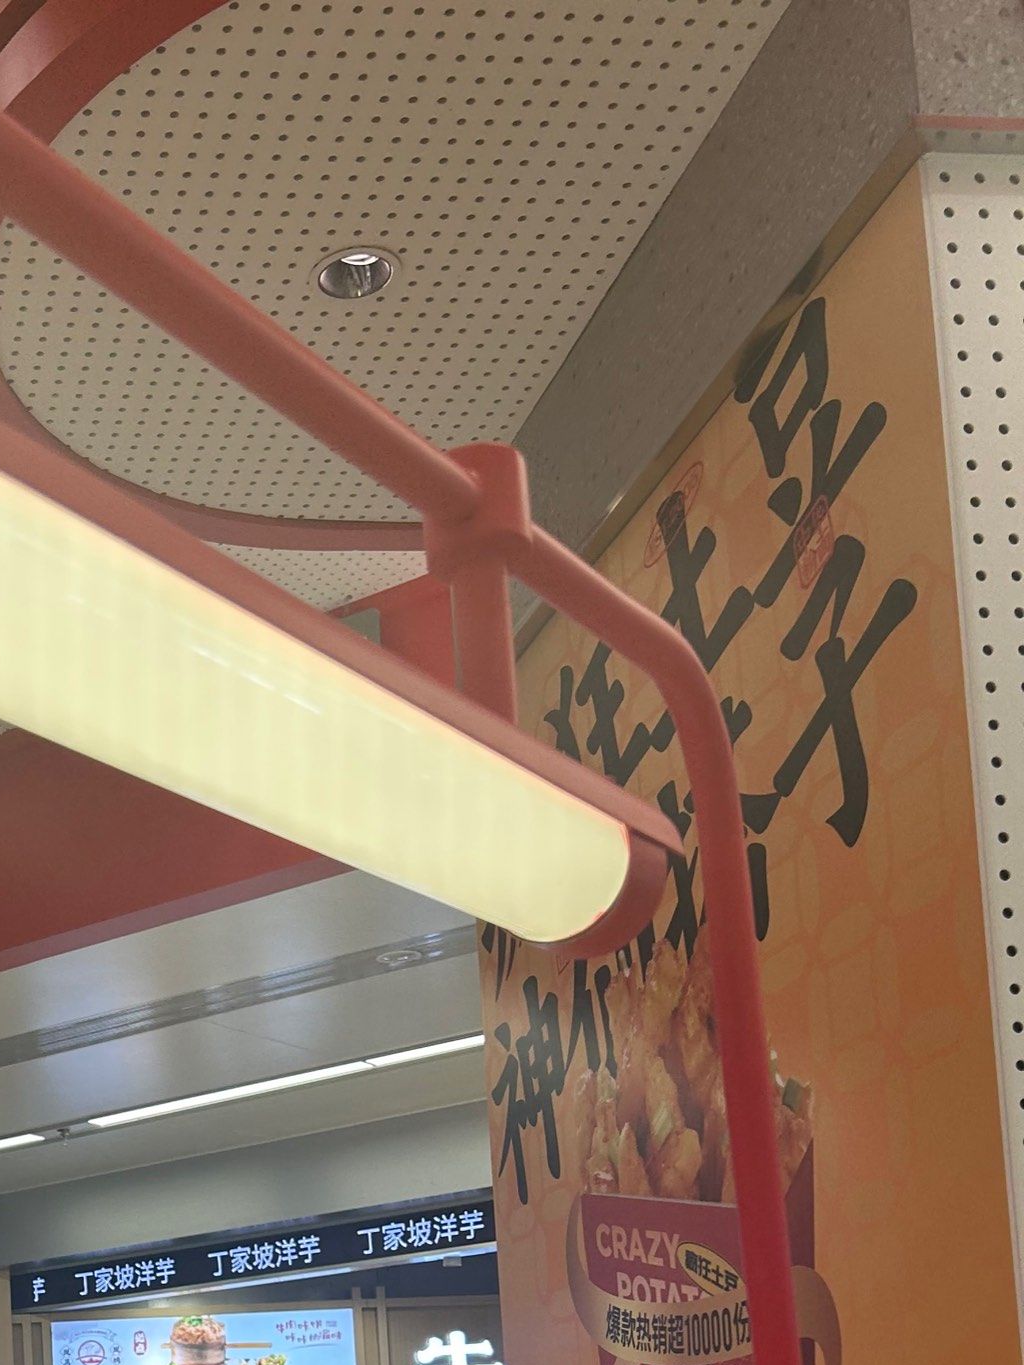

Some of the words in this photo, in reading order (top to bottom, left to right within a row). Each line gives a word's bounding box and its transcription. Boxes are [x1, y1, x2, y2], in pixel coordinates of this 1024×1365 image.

[357, 1210, 484, 1256] 丁家坡洋芋
[595, 1223, 680, 1269] CRAZY
[74, 1258, 175, 1296] 丁家坡洋芋
[208, 1235, 321, 1277] 丁家坡洋芋
[616, 1272, 712, 1304] POTAT
[605, 1300, 751, 1356] 爆款热销超10000份
